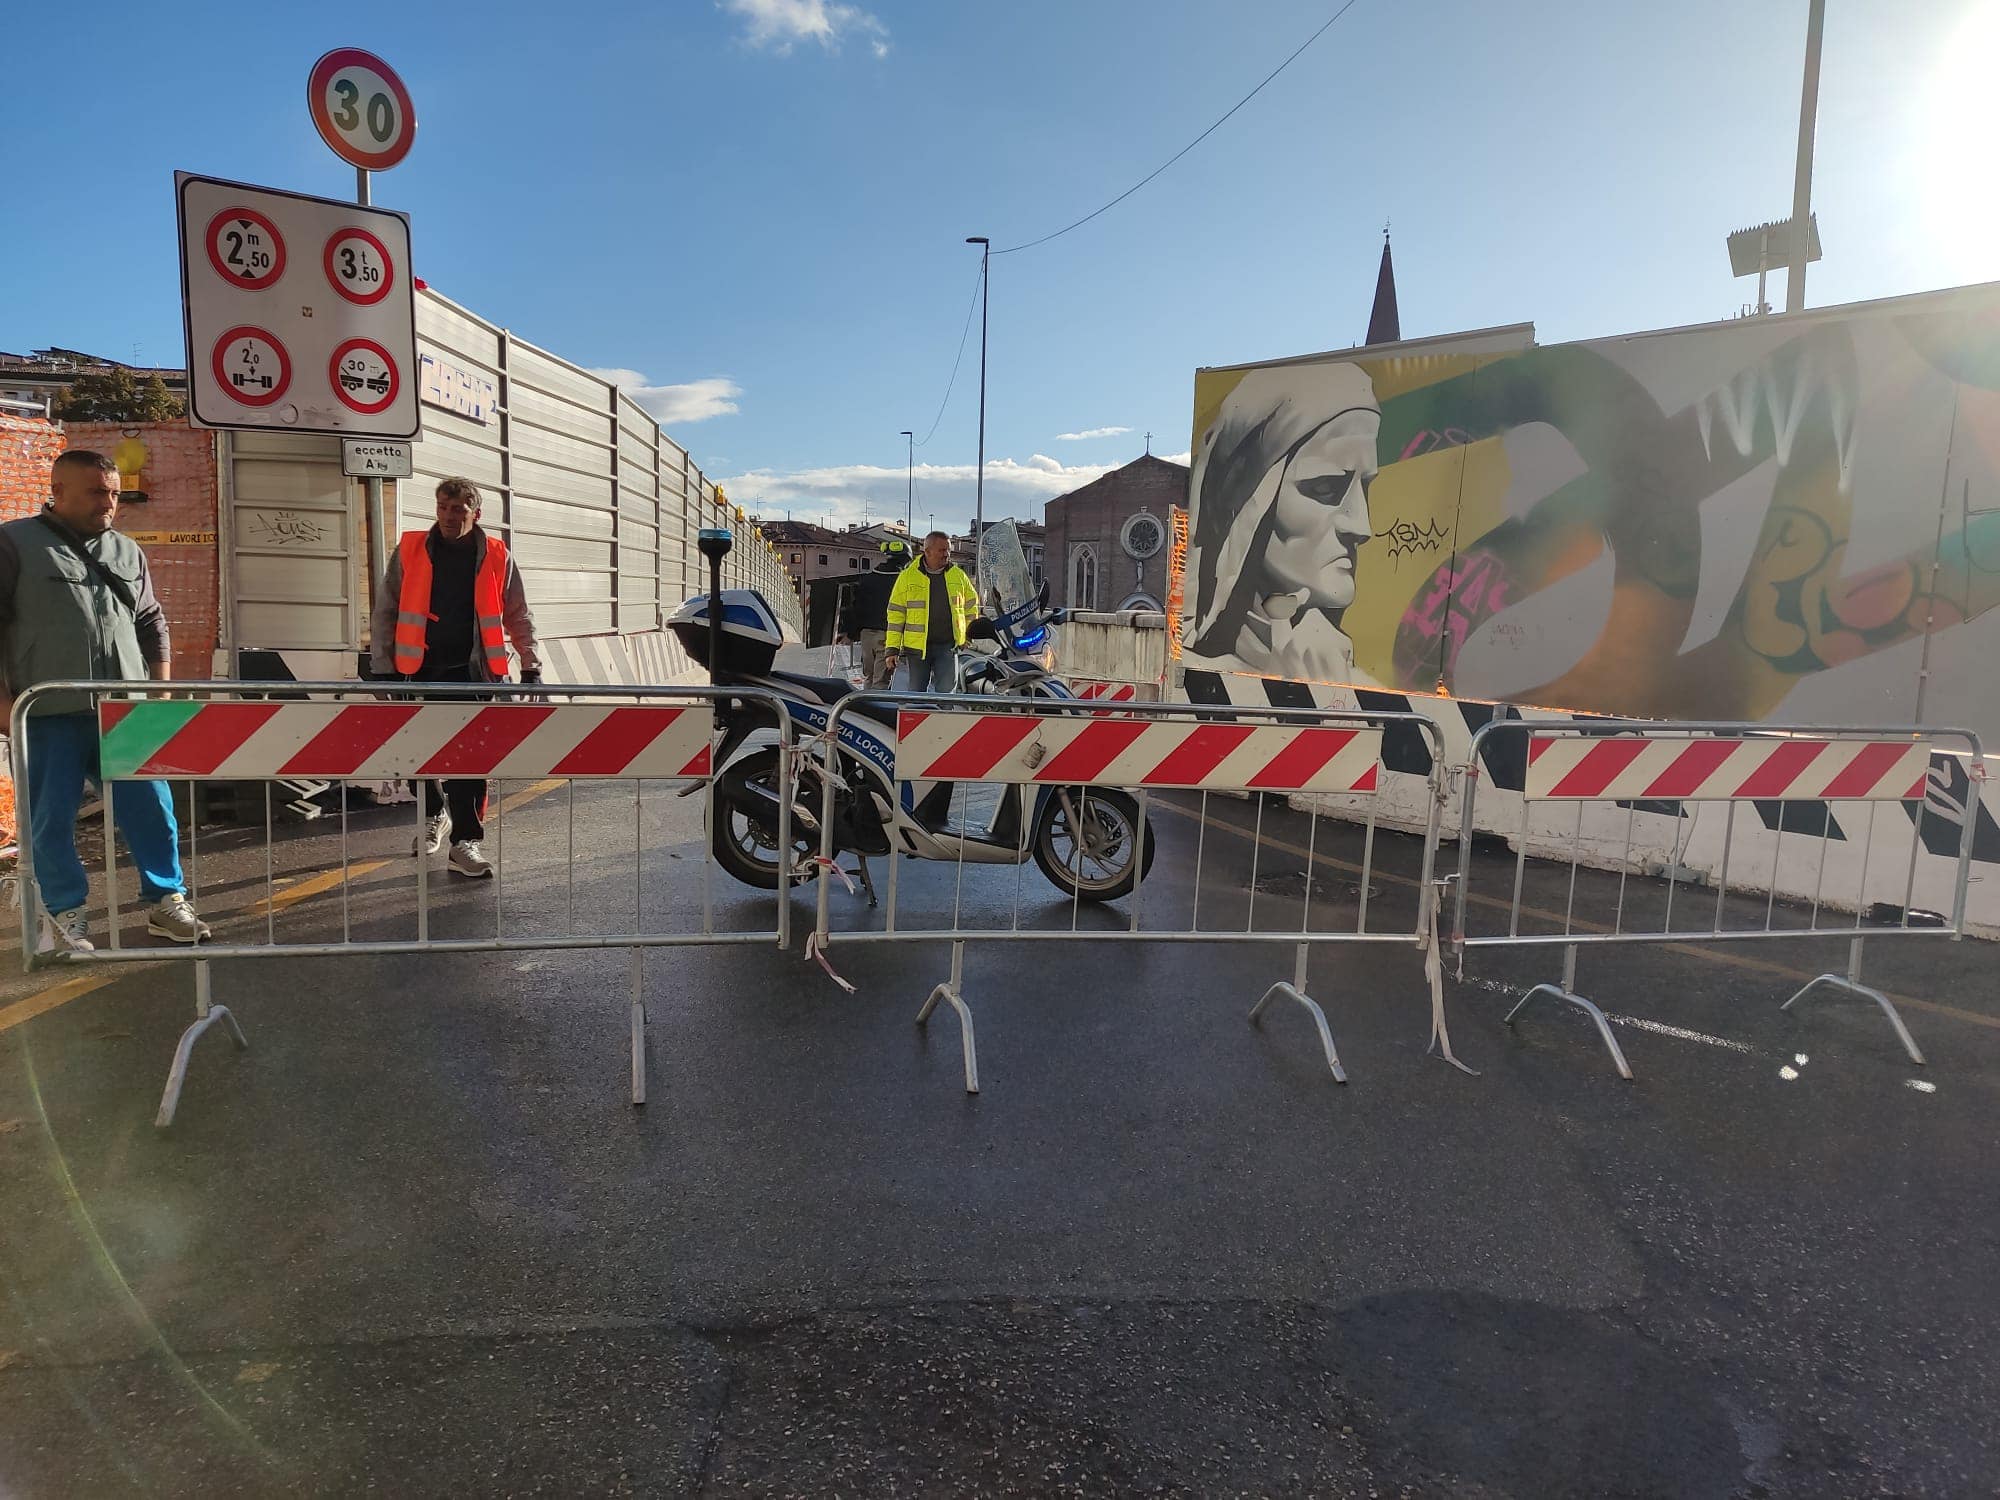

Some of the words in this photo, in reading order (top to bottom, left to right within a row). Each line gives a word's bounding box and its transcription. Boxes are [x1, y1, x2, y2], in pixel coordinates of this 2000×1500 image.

[333, 78, 395, 143] 30
[247, 233, 260, 246] m
[347, 359, 366, 372] 30
[354, 445, 402, 457] eccetto
[169, 533, 201, 543] LAVORI
[855, 735, 896, 772] LOCALE
